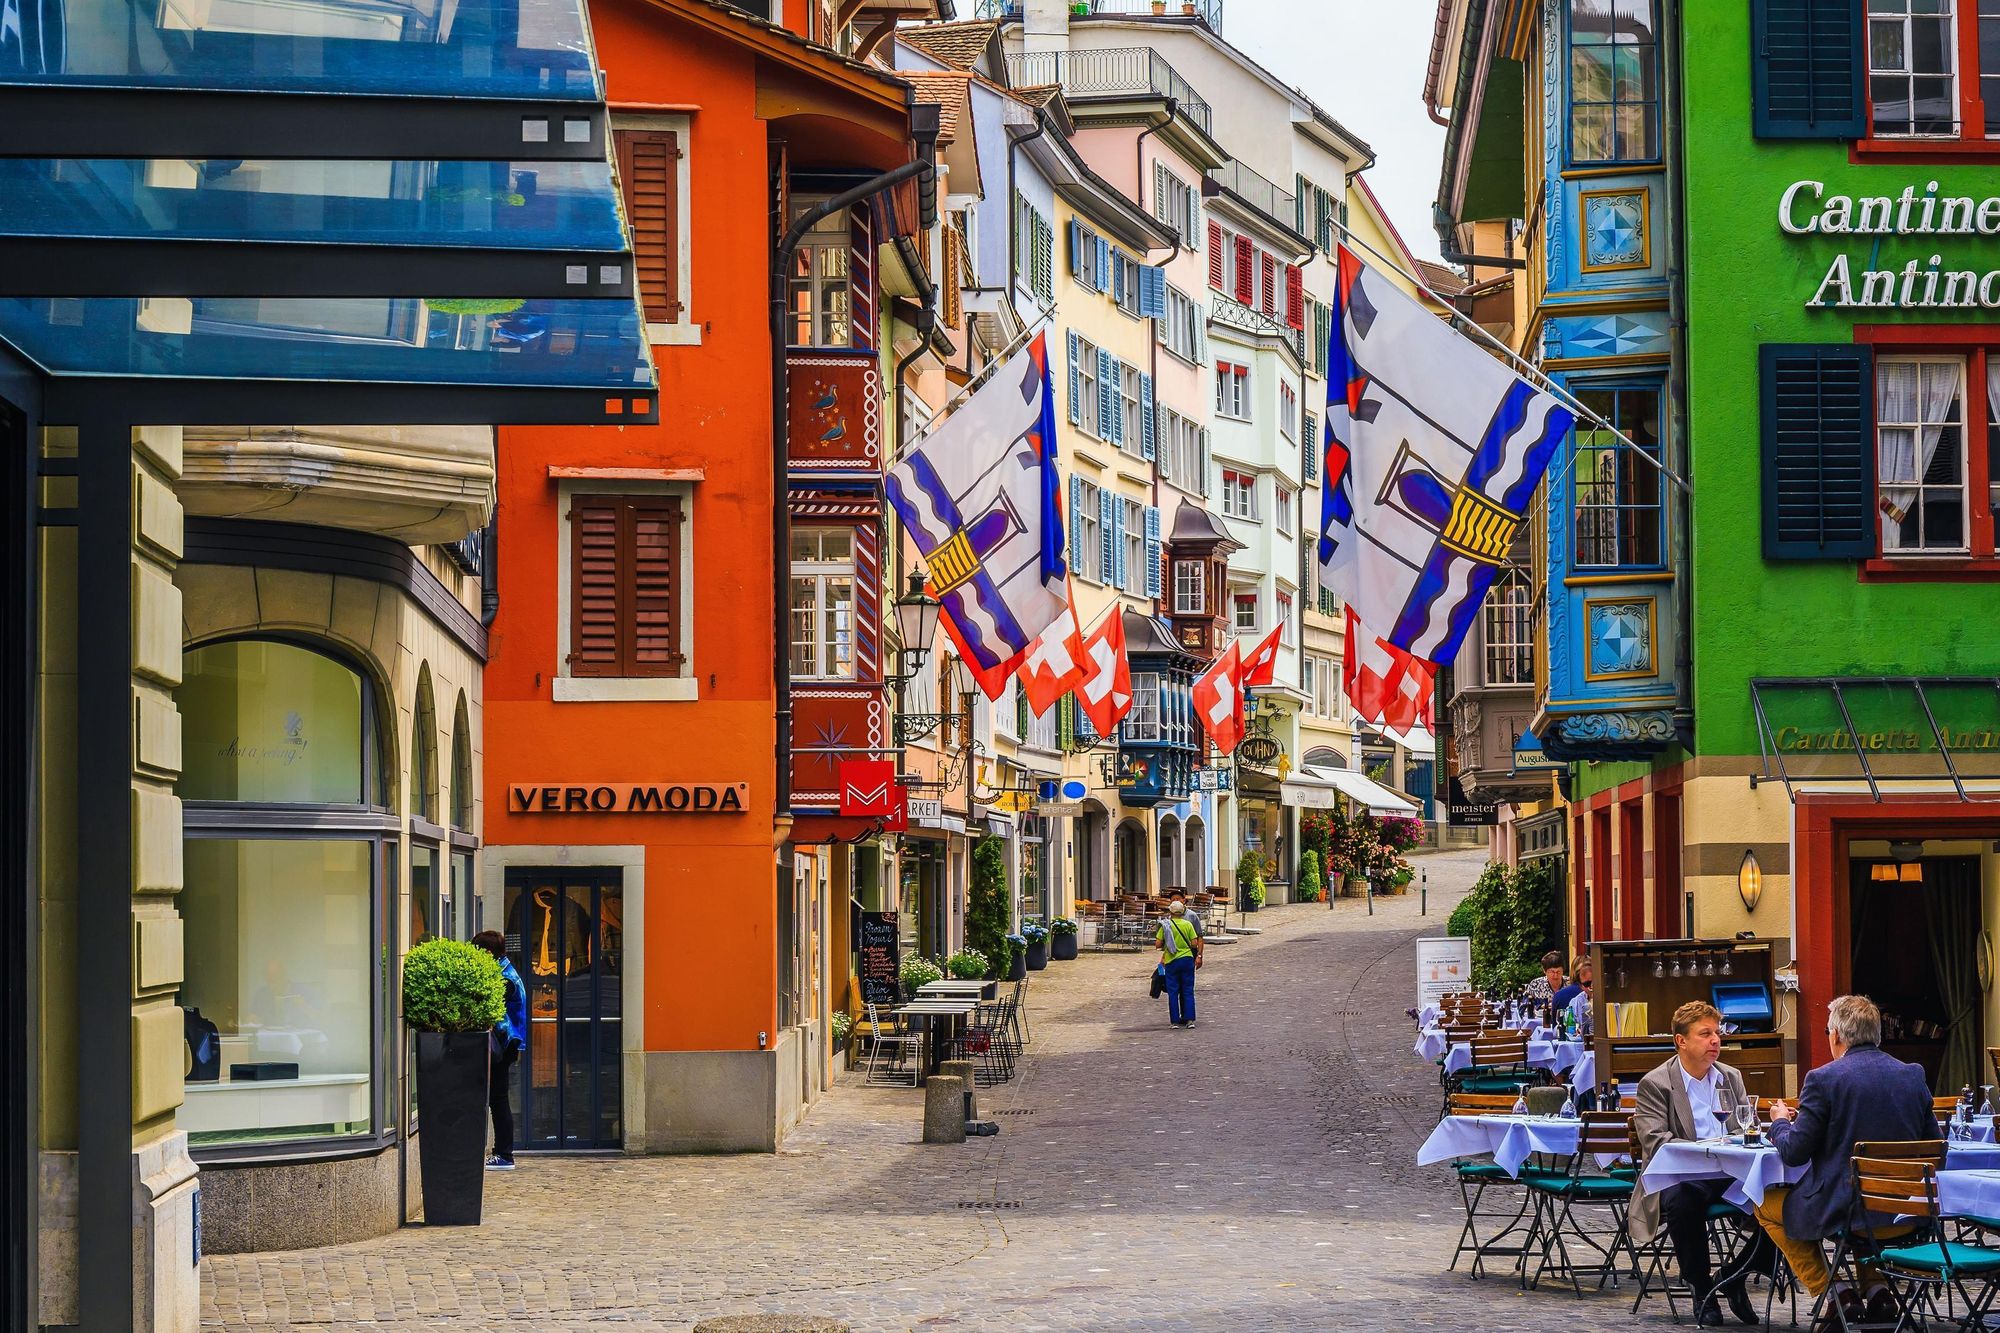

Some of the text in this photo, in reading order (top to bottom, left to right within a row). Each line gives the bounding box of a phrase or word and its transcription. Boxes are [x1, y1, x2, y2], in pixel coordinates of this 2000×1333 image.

[1778, 180, 2000, 235] Cantine
[514, 786, 743, 810] VERO MODA
[1451, 803, 1496, 813] meister
